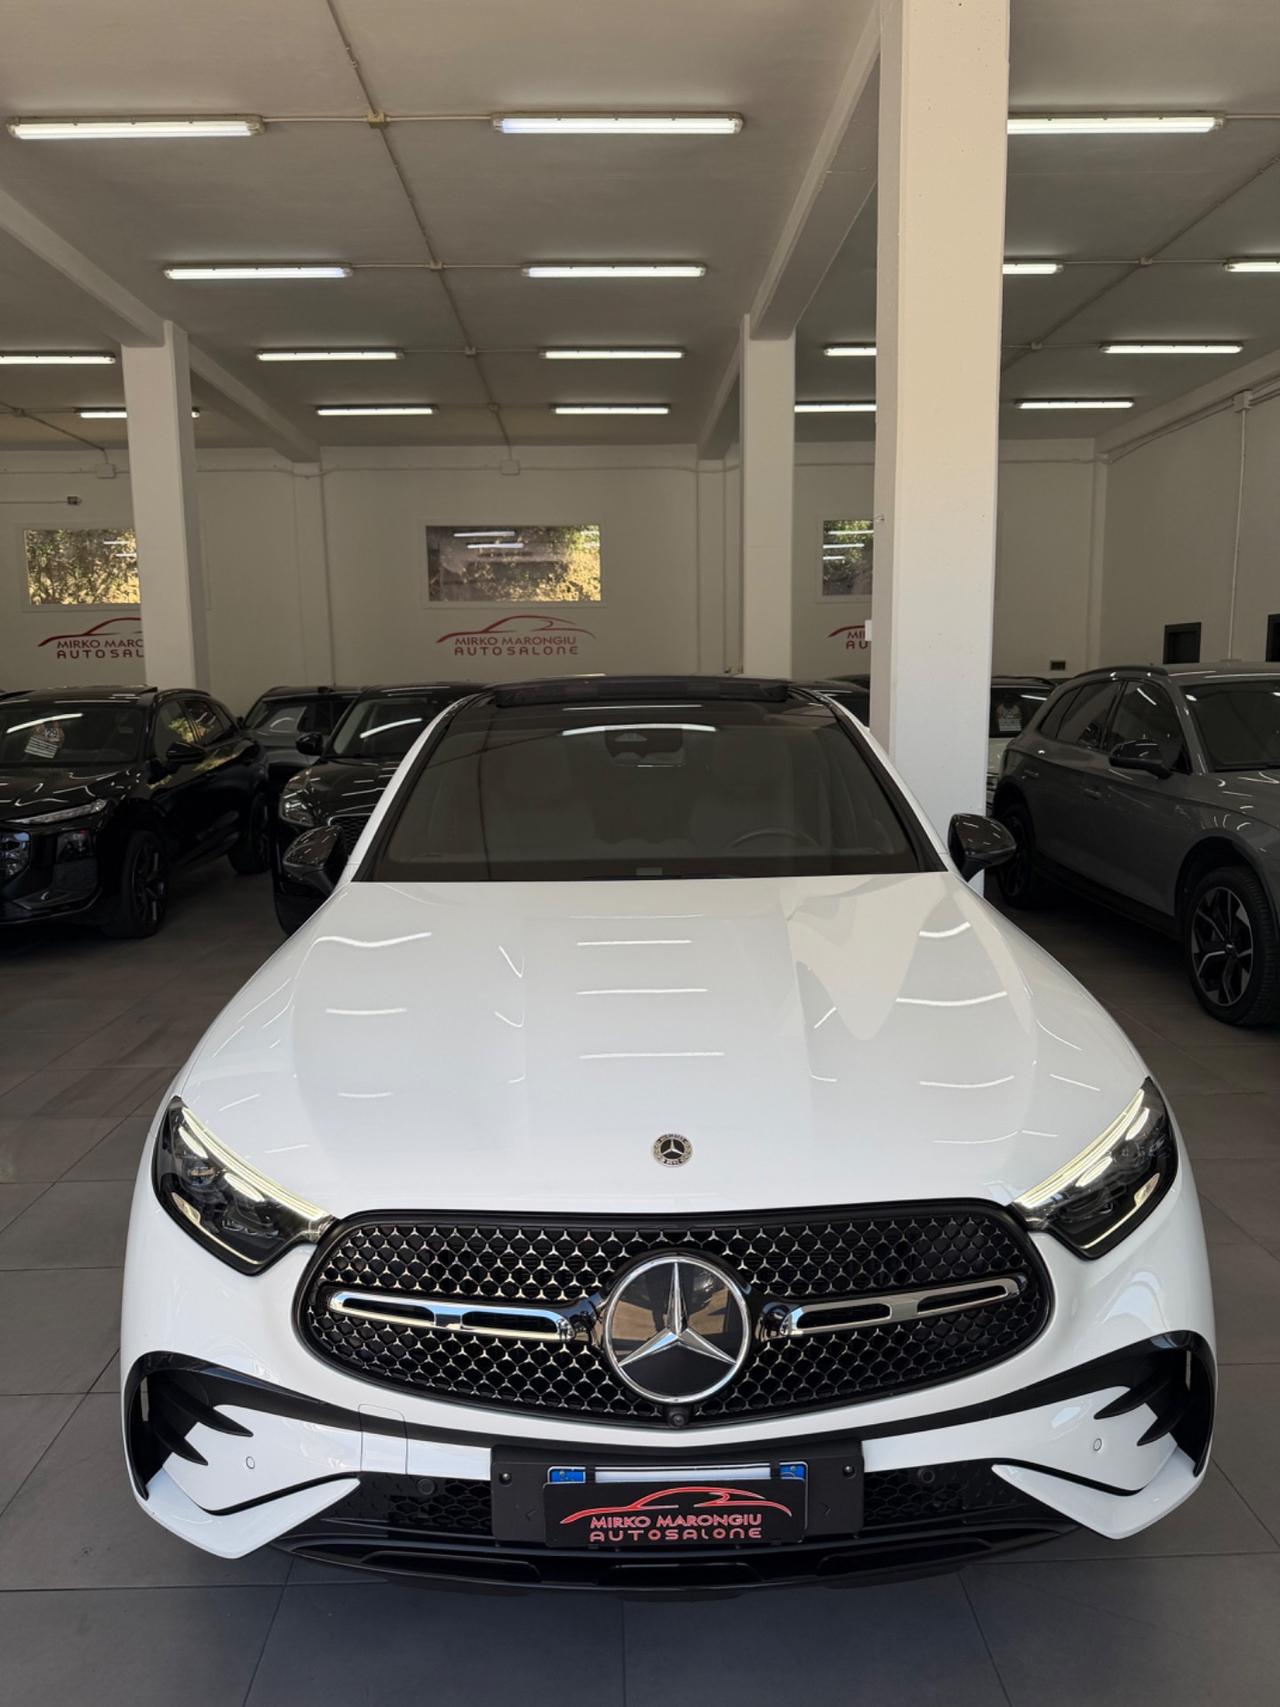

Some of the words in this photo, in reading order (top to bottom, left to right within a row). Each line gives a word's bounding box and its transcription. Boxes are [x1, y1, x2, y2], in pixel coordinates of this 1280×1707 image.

[57, 640, 101, 649] MIRKO
[455, 636, 498, 646] MIRKO
[502, 636, 577, 645] MARONGIU
[454, 646, 578, 656] AUTOSALONE
[590, 1516, 651, 1529] MIRKO
[656, 1513, 762, 1527] MARONGIU
[589, 1527, 762, 1542] AUTOSALONE
